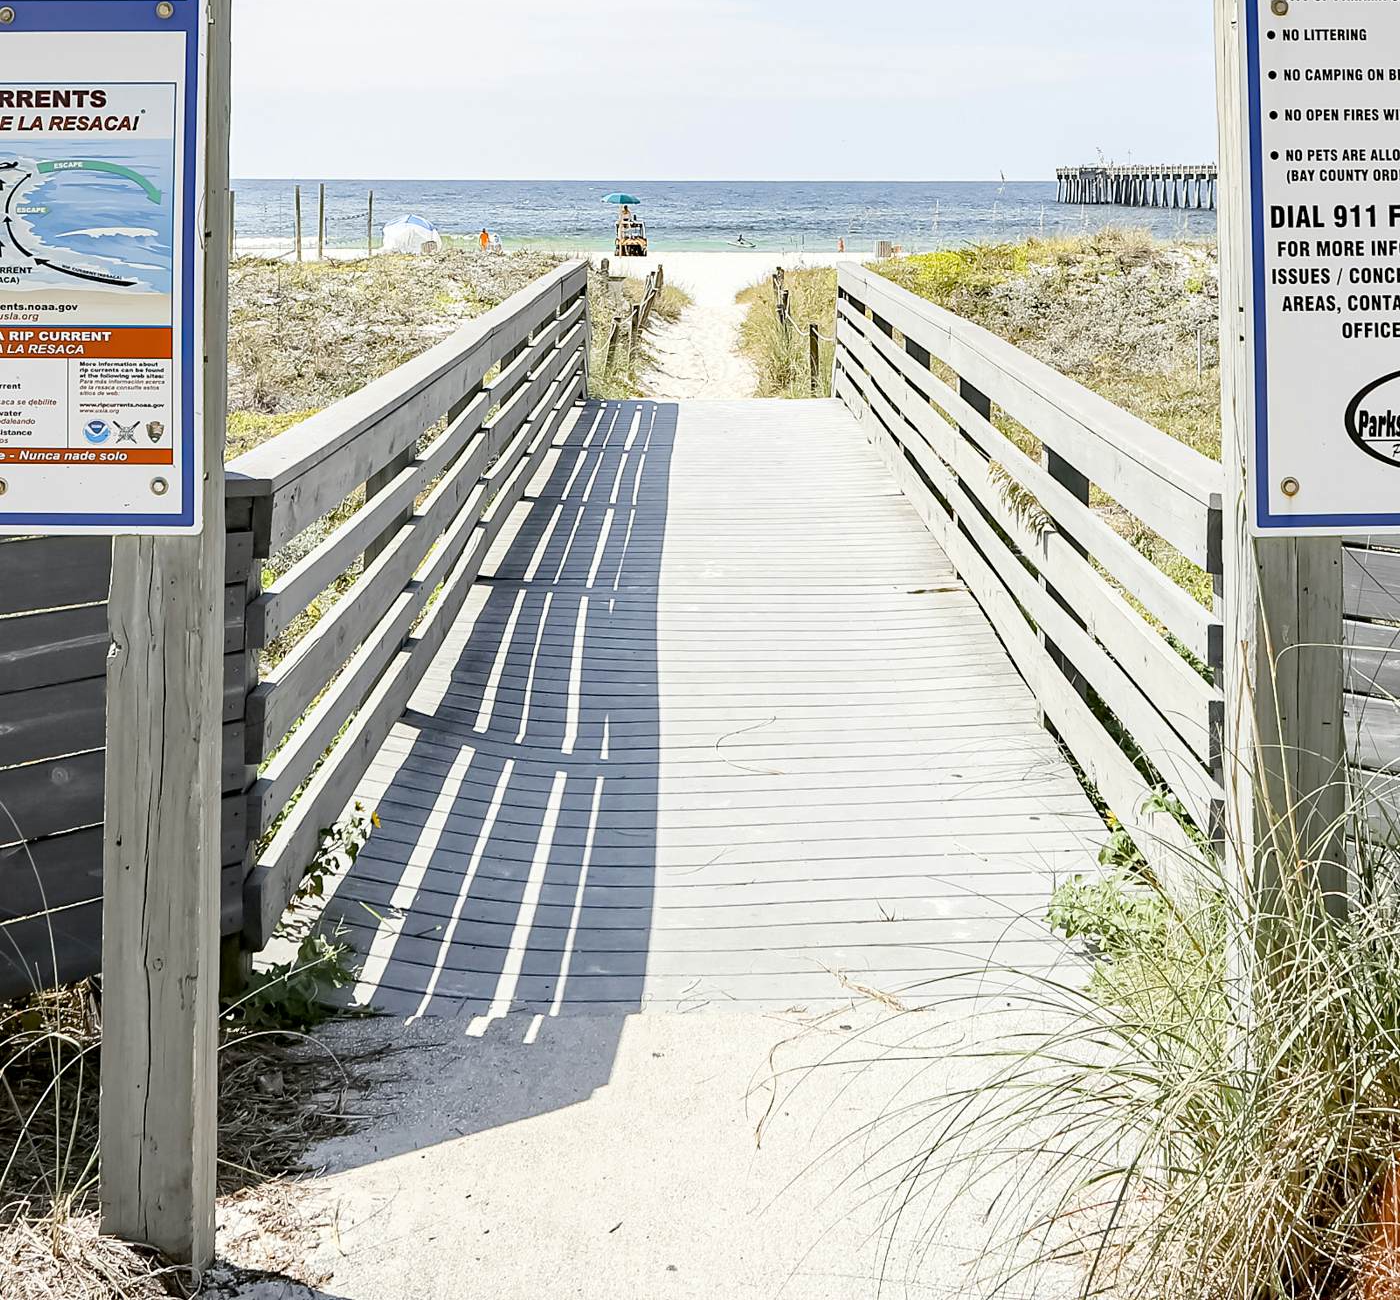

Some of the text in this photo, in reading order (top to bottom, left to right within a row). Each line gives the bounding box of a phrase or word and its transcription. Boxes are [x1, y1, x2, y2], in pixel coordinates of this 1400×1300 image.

[1282, 29, 1367, 41] NO LITTERING
[1284, 69, 1300, 81] NO
[1305, 69, 1363, 81] CAMPING
[1367, 69, 1384, 81] ON
[0, 90, 107, 108] RRENTS
[1285, 109, 1379, 121] NO OPEN FIRES
[18, 116, 43, 130] LA
[1286, 150, 1400, 161] NO PETS ARE ALLO
[53, 161, 83, 169] ESCAPE
[1287, 170, 1368, 184] (BAY COUNTY
[1271, 205, 1325, 228] DIAL
[1334, 205, 1376, 228] 911
[1278, 241, 1365, 257] FOR MORE
[1272, 268, 1330, 284] ISSUES
[1282, 295, 1400, 313] AREAS, CONTA
[9, 332, 34, 341] RIP
[39, 331, 111, 341] CURRENT
[1342, 322, 1400, 338] OFFICE
[7, 345, 24, 354] LA
[28, 344, 84, 354] RESACA
[20, 450, 128, 460] Nunca nade solo
